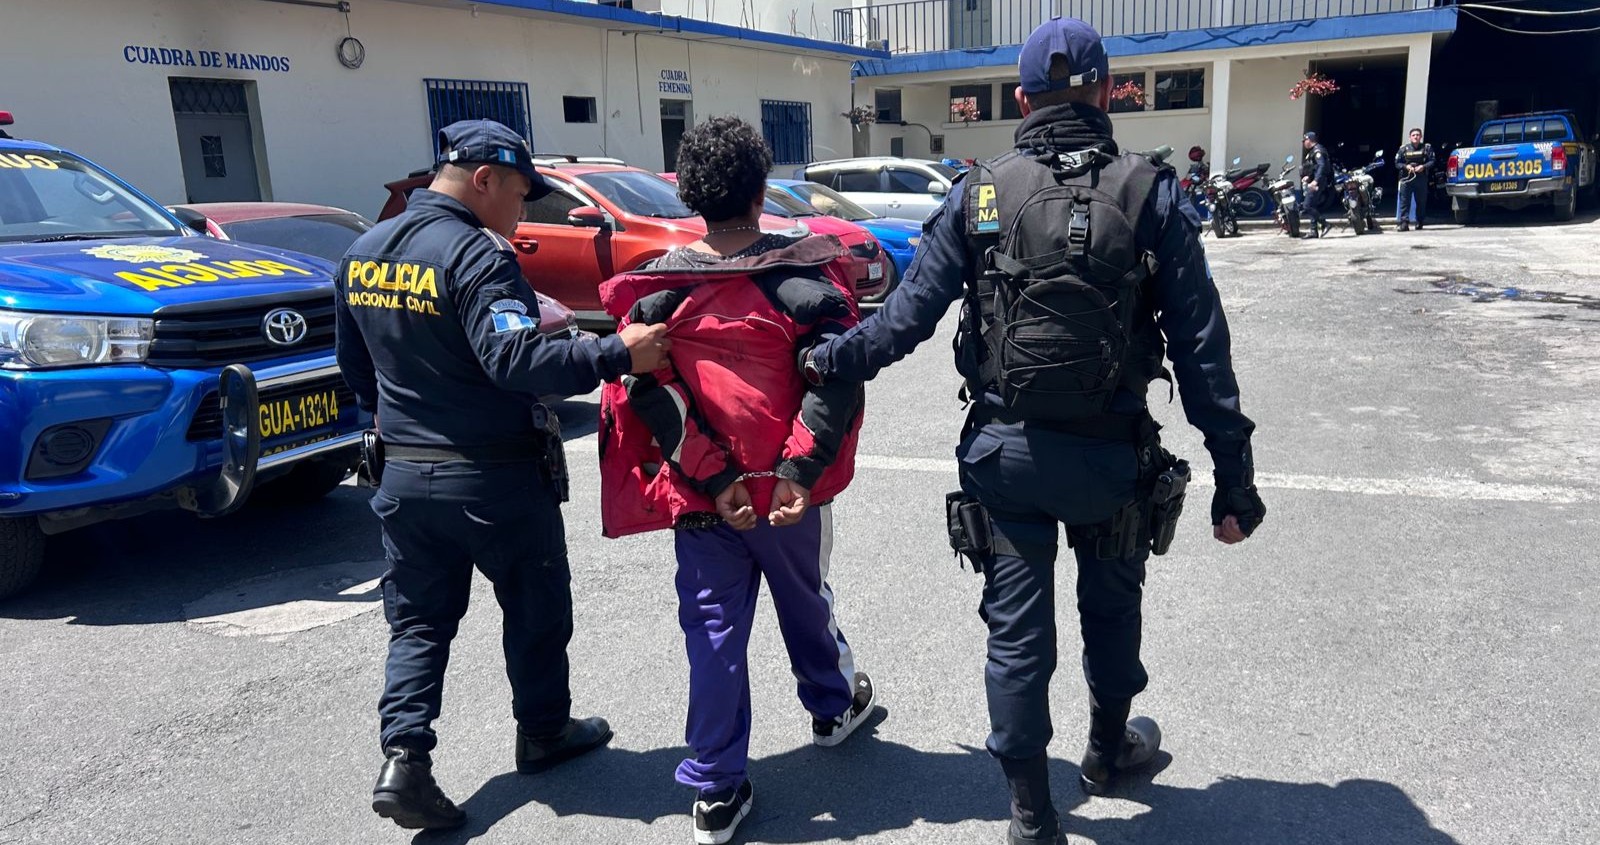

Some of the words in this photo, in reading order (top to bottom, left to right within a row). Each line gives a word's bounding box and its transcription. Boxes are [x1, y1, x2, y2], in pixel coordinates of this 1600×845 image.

[123, 45, 197, 67] CUADRA
[199, 50, 223, 68] DE
[225, 52, 290, 72] MANDOS
[660, 69, 688, 81] CUADRA
[1464, 159, 1543, 179] GUA-13305
[348, 260, 439, 298] POLICIA
[347, 291, 404, 309] NACIONAL
[406, 295, 441, 316] CIVIL
[258, 390, 339, 437] GUA-13214
